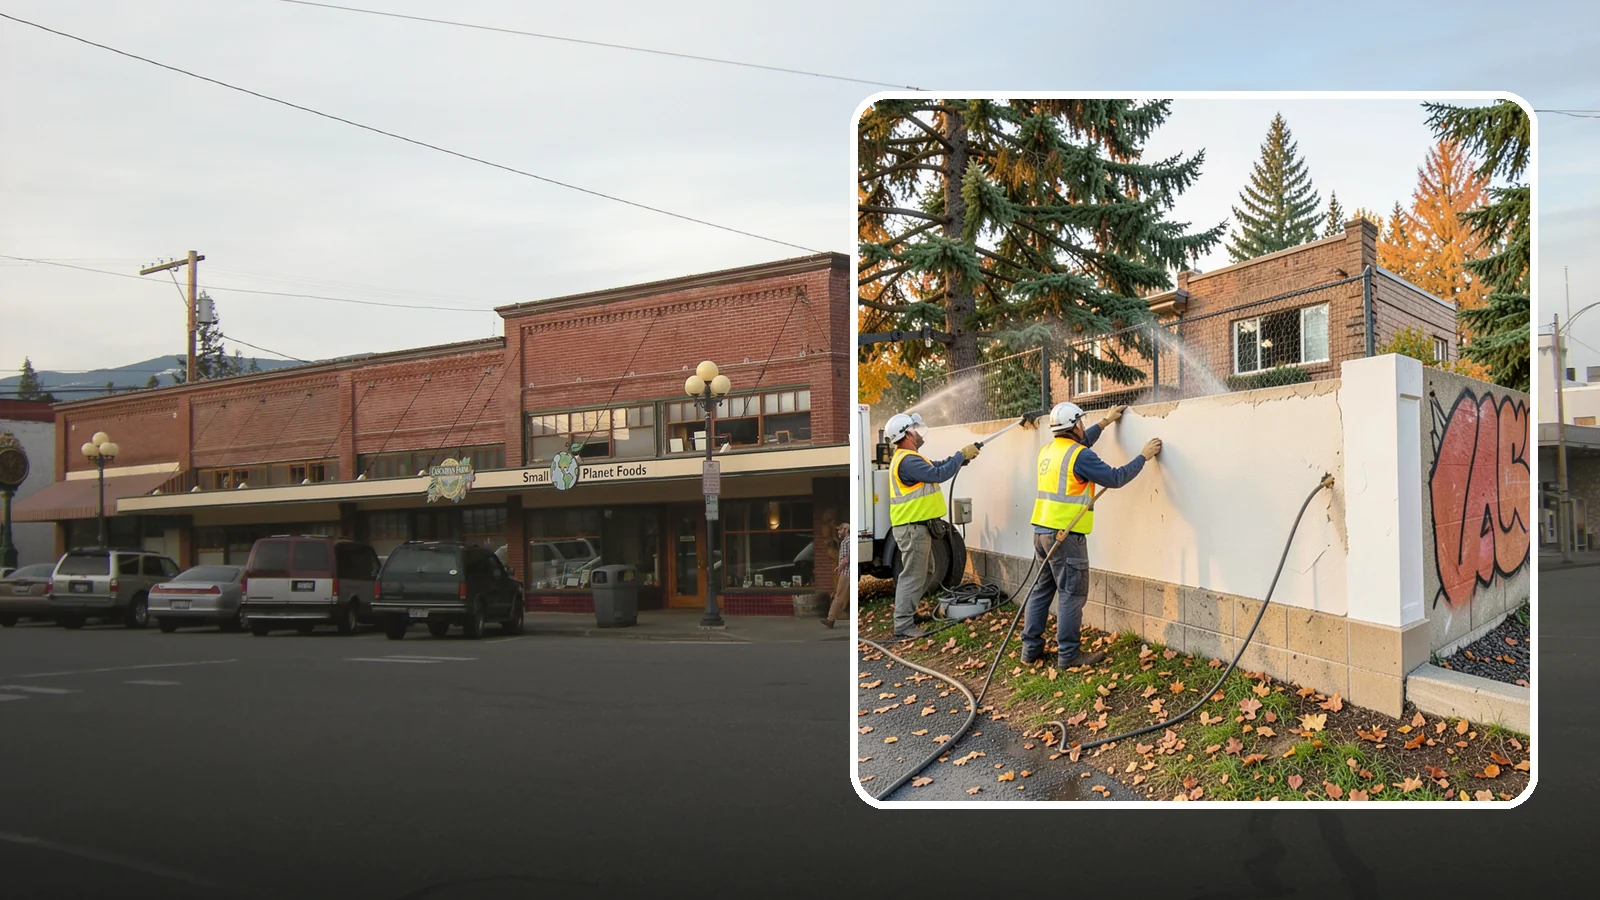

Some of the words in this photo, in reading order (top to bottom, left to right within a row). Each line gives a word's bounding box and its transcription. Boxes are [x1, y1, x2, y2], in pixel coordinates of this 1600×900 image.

[523, 470, 549, 483] Small
[583, 467, 614, 479] Planet
[617, 464, 647, 476] Foods
